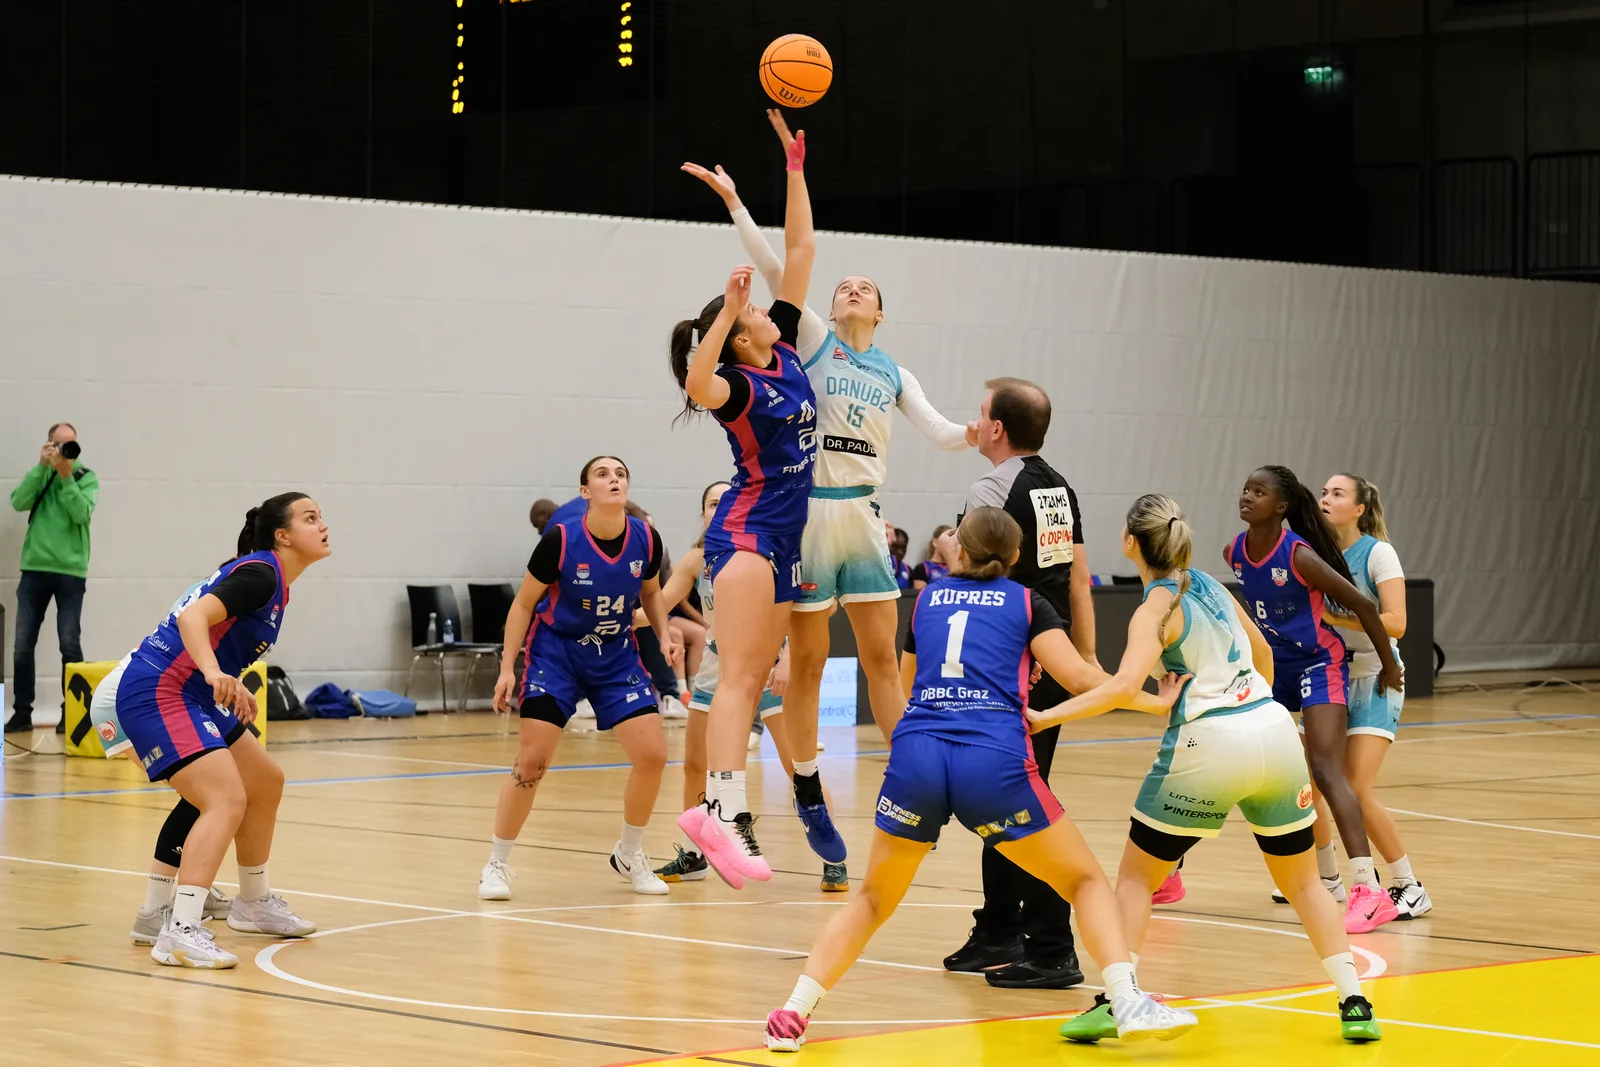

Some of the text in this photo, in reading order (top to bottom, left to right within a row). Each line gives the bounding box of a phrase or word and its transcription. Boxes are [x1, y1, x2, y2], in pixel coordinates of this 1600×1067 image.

[846, 403, 866, 428] 15
[826, 438, 845, 450] DR.
[596, 594, 625, 616] 24
[1256, 600, 1267, 620] 6
[940, 609, 970, 678] 1
[957, 686, 989, 700] Graz
[1198, 799, 1216, 807] AG
